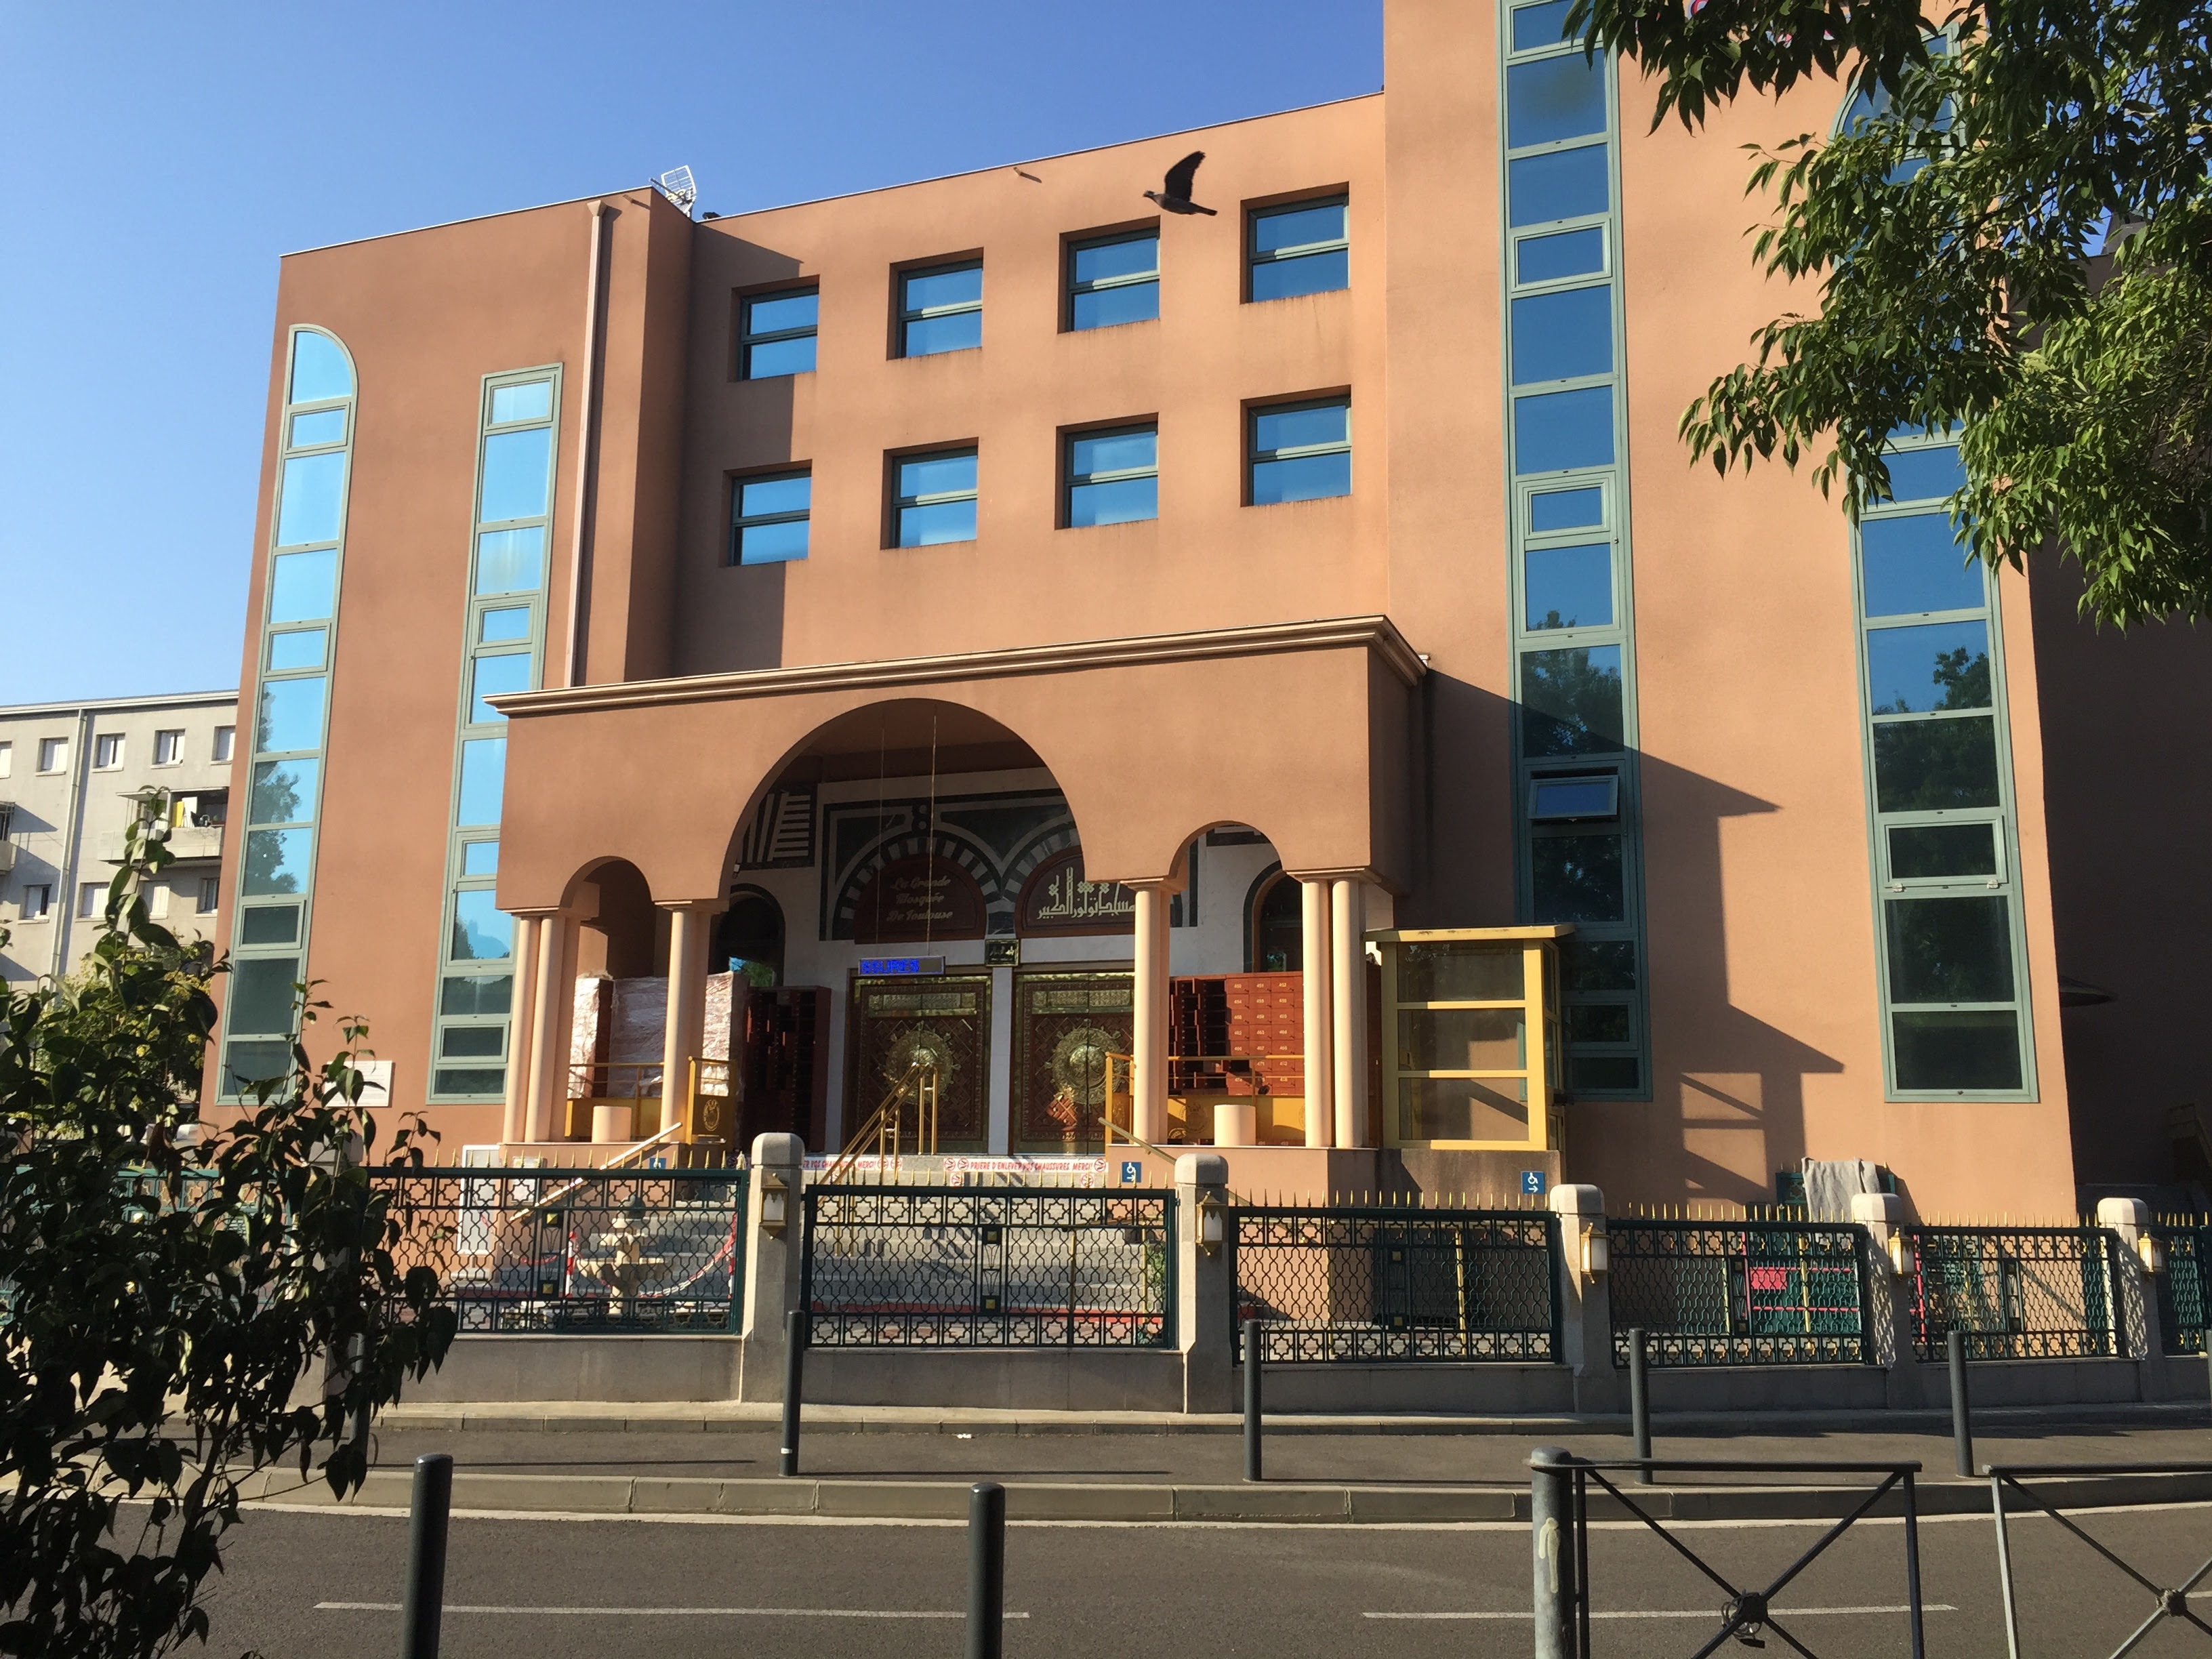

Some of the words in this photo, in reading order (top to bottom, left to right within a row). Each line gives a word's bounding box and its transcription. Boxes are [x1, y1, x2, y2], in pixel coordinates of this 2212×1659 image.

[890, 877, 909, 890] La
[910, 875, 951, 888] Grande
[896, 892, 944, 906] Mosquée
[906, 909, 953, 920] Toulouse
[862, 959, 920, 974] SSURES
